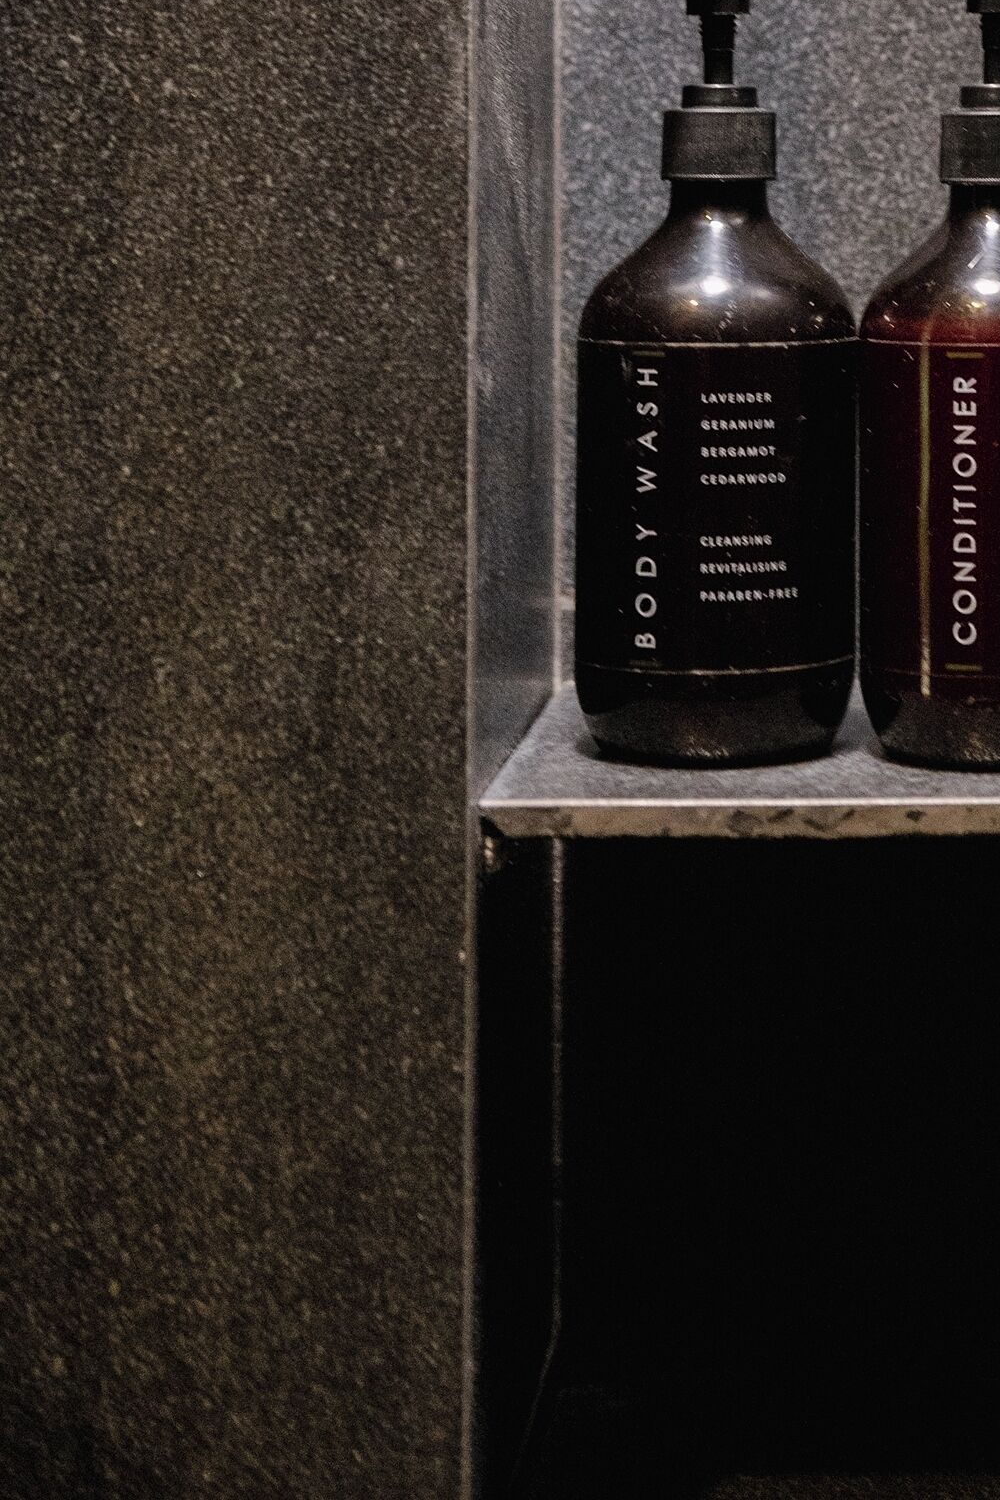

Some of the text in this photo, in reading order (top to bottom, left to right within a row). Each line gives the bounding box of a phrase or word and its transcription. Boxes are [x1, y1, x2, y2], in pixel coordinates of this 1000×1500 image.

[701, 392, 772, 403] LAVENDER
[700, 419, 775, 430] GERANIUM
[701, 446, 776, 457] BERGAMOT
[700, 473, 786, 485] CEDARWOOD
[634, 367, 659, 649] BODY WASH
[952, 376, 977, 645] CONDITIONER
[699, 534, 772, 547] CLEANSING
[699, 561, 787, 574] REVITALISING
[699, 587, 799, 602] PARABEN-FREE
